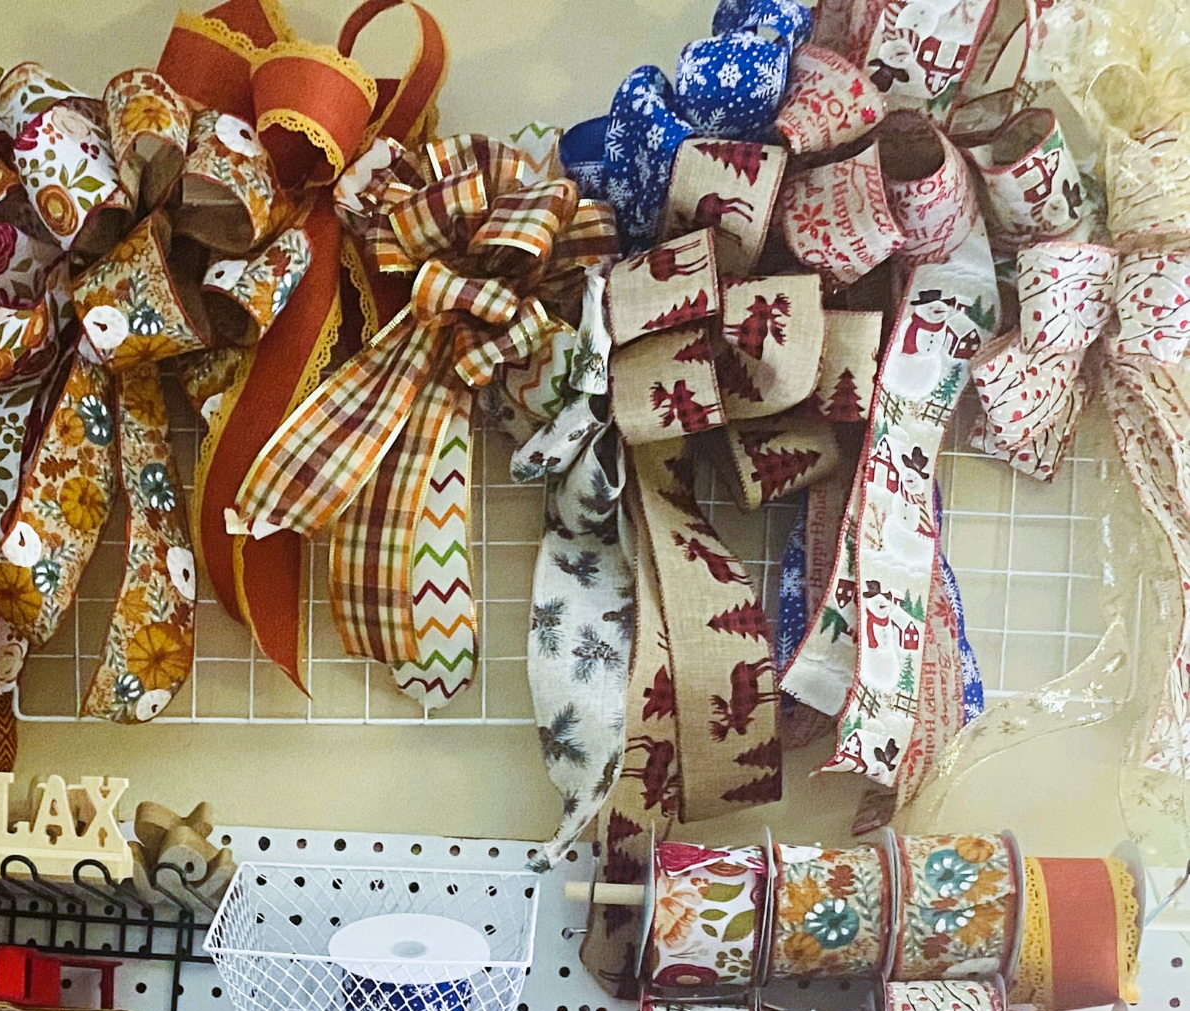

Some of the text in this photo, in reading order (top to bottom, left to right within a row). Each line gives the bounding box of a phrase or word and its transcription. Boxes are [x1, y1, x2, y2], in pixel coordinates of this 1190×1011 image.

[815, 88, 852, 132] JOY
[832, 178, 857, 238] Happy
[922, 661, 937, 714] Happy
